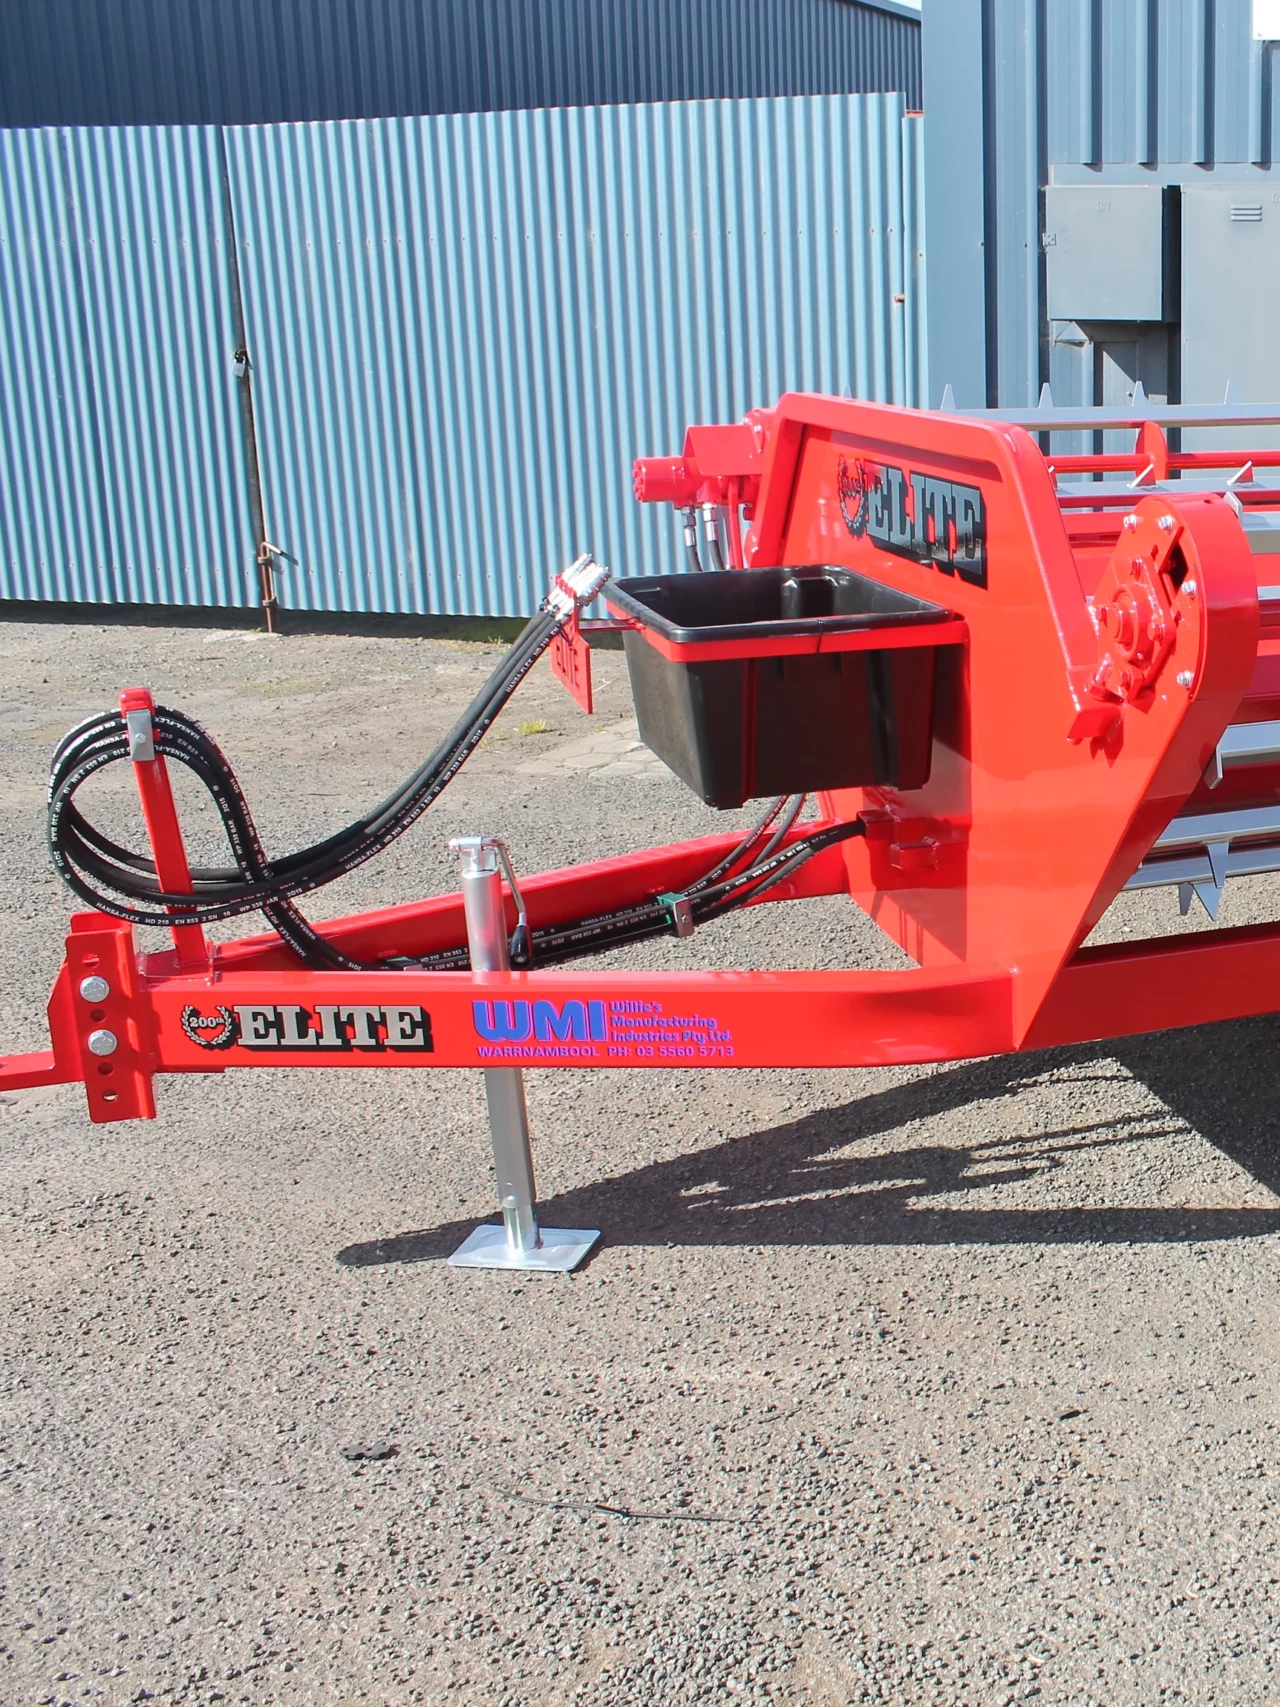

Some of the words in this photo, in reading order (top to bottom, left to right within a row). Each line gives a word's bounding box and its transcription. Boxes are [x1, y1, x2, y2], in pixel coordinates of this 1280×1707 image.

[864, 459, 986, 587] ELITE
[96, 902, 139, 922] HANSA-FLEX
[610, 1000, 662, 1013] Willie's
[188, 1016, 225, 1029] 200th
[233, 1005, 431, 1050] ELITE
[472, 1000, 608, 1042] WMI
[611, 1013, 717, 1030] Manufacturing
[612, 1029, 680, 1042] Industries
[478, 1046, 599, 1057] WARRNAMBOOL
[608, 1046, 632, 1057] PH:
[636, 1045, 654, 1057] 03
[658, 1045, 694, 1057] 5560
[699, 1045, 734, 1057] 5713
